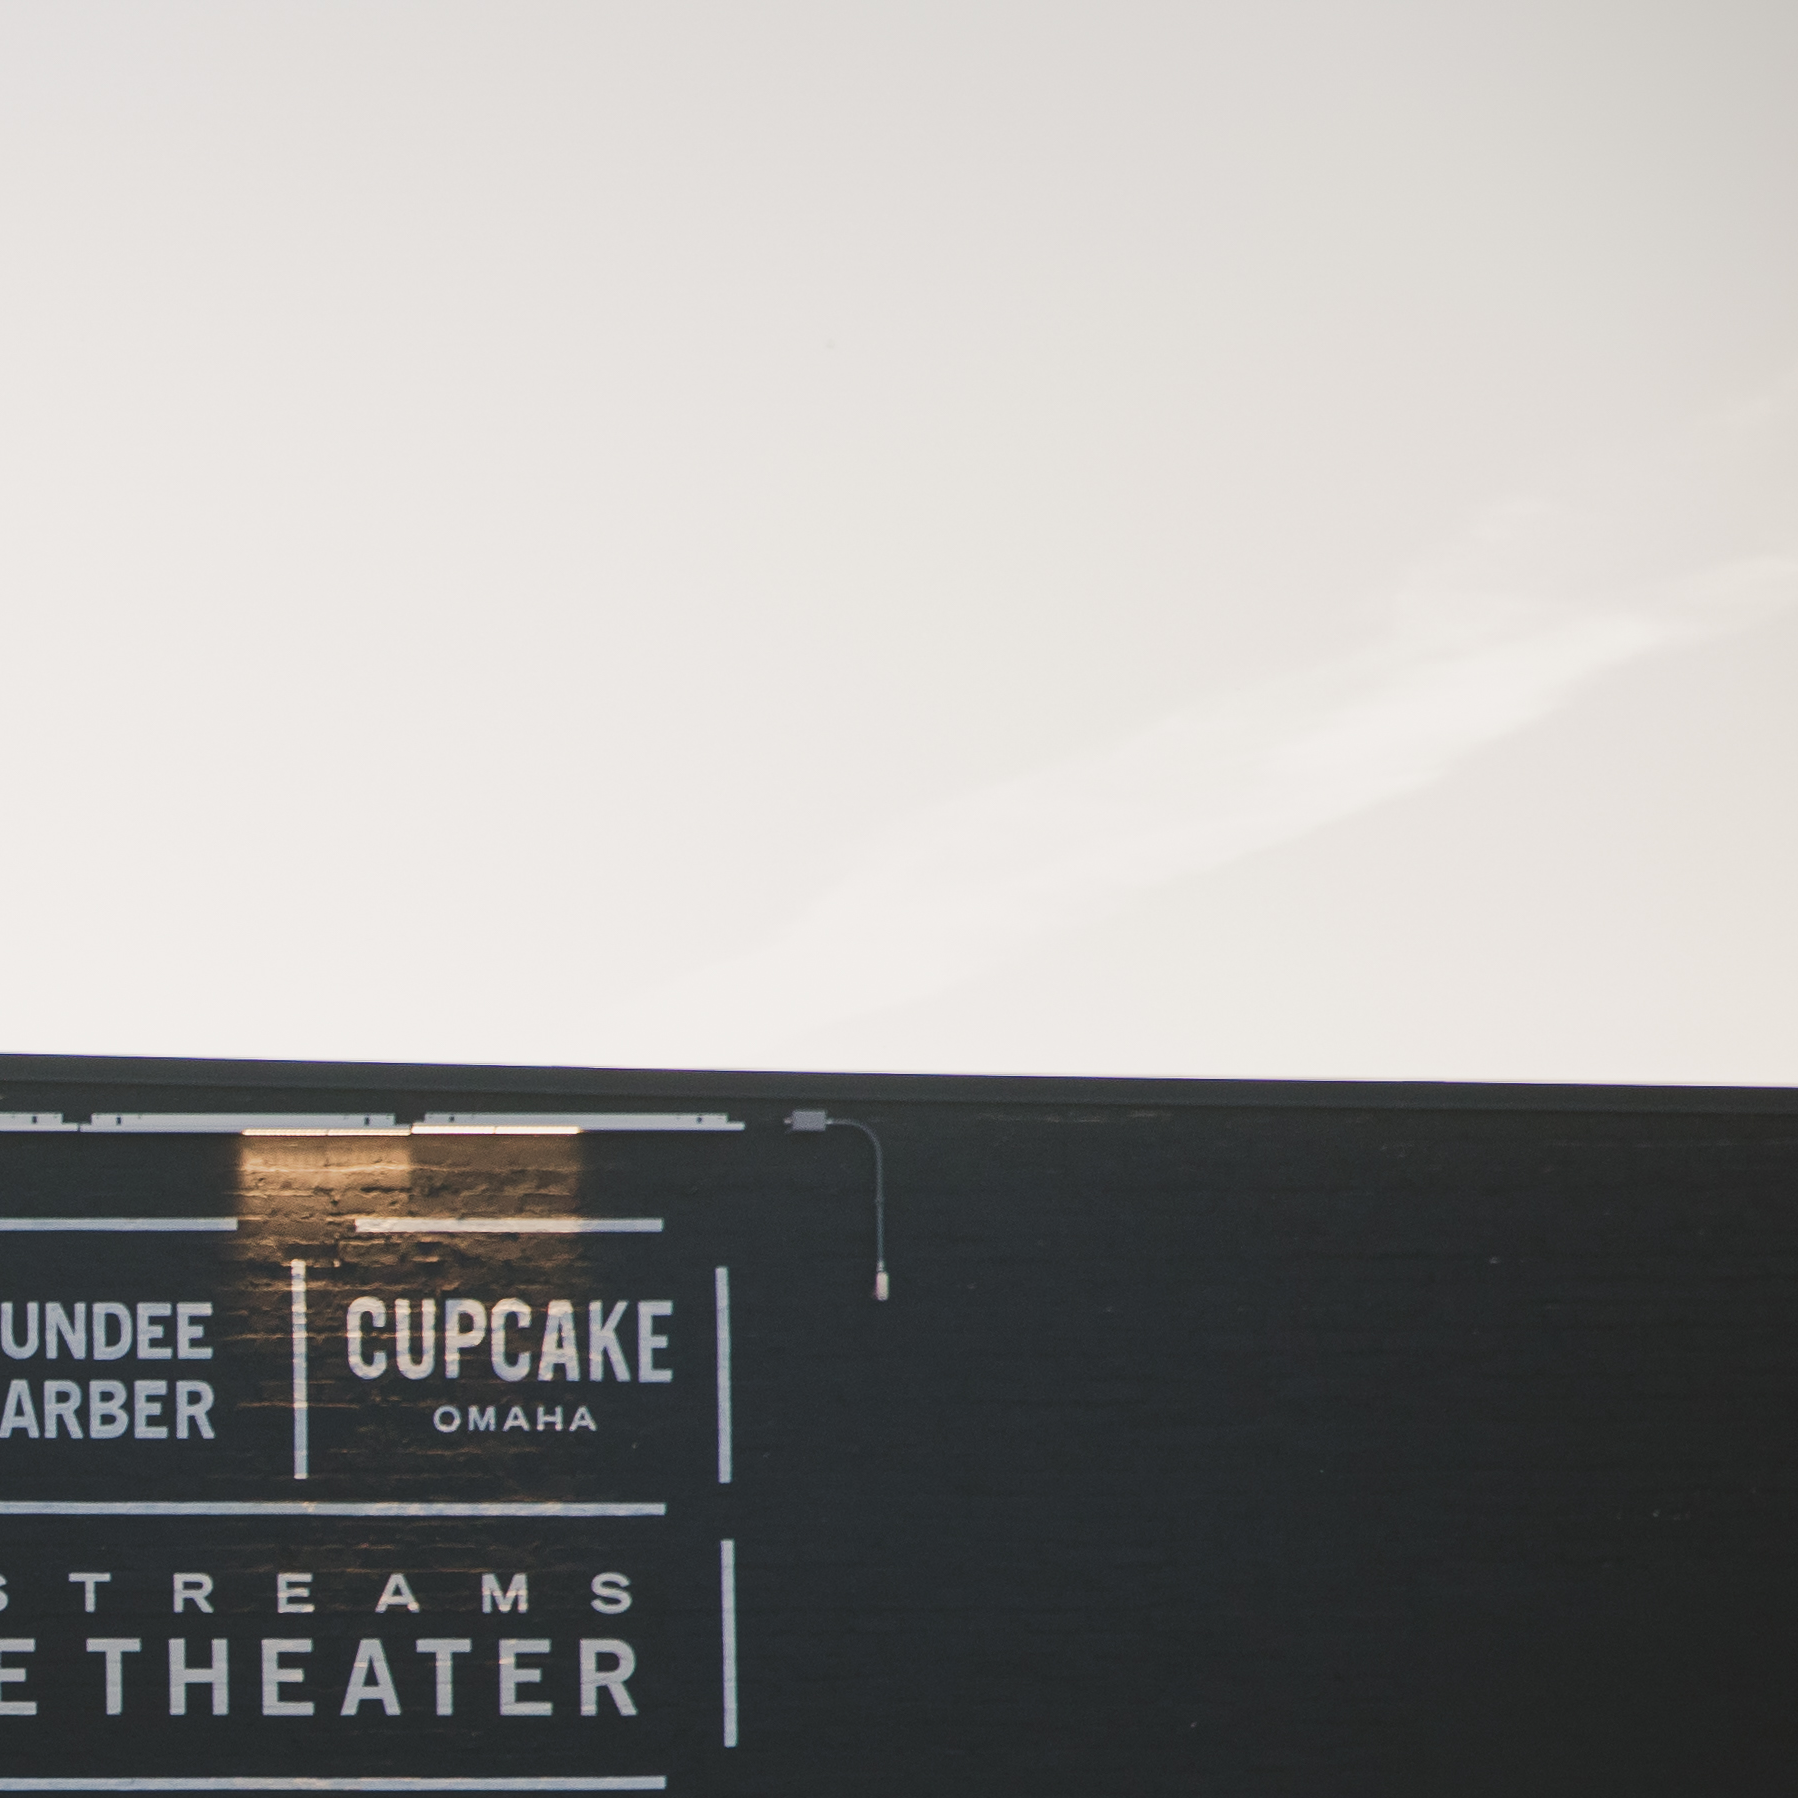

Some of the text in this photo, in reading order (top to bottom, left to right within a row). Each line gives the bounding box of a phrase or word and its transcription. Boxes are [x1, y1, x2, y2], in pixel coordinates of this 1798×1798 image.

[345, 1295, 674, 1383] CUPCAKE
[432, 1404, 598, 1433] OMAHA
[85, 1637, 638, 1717] THEATER
